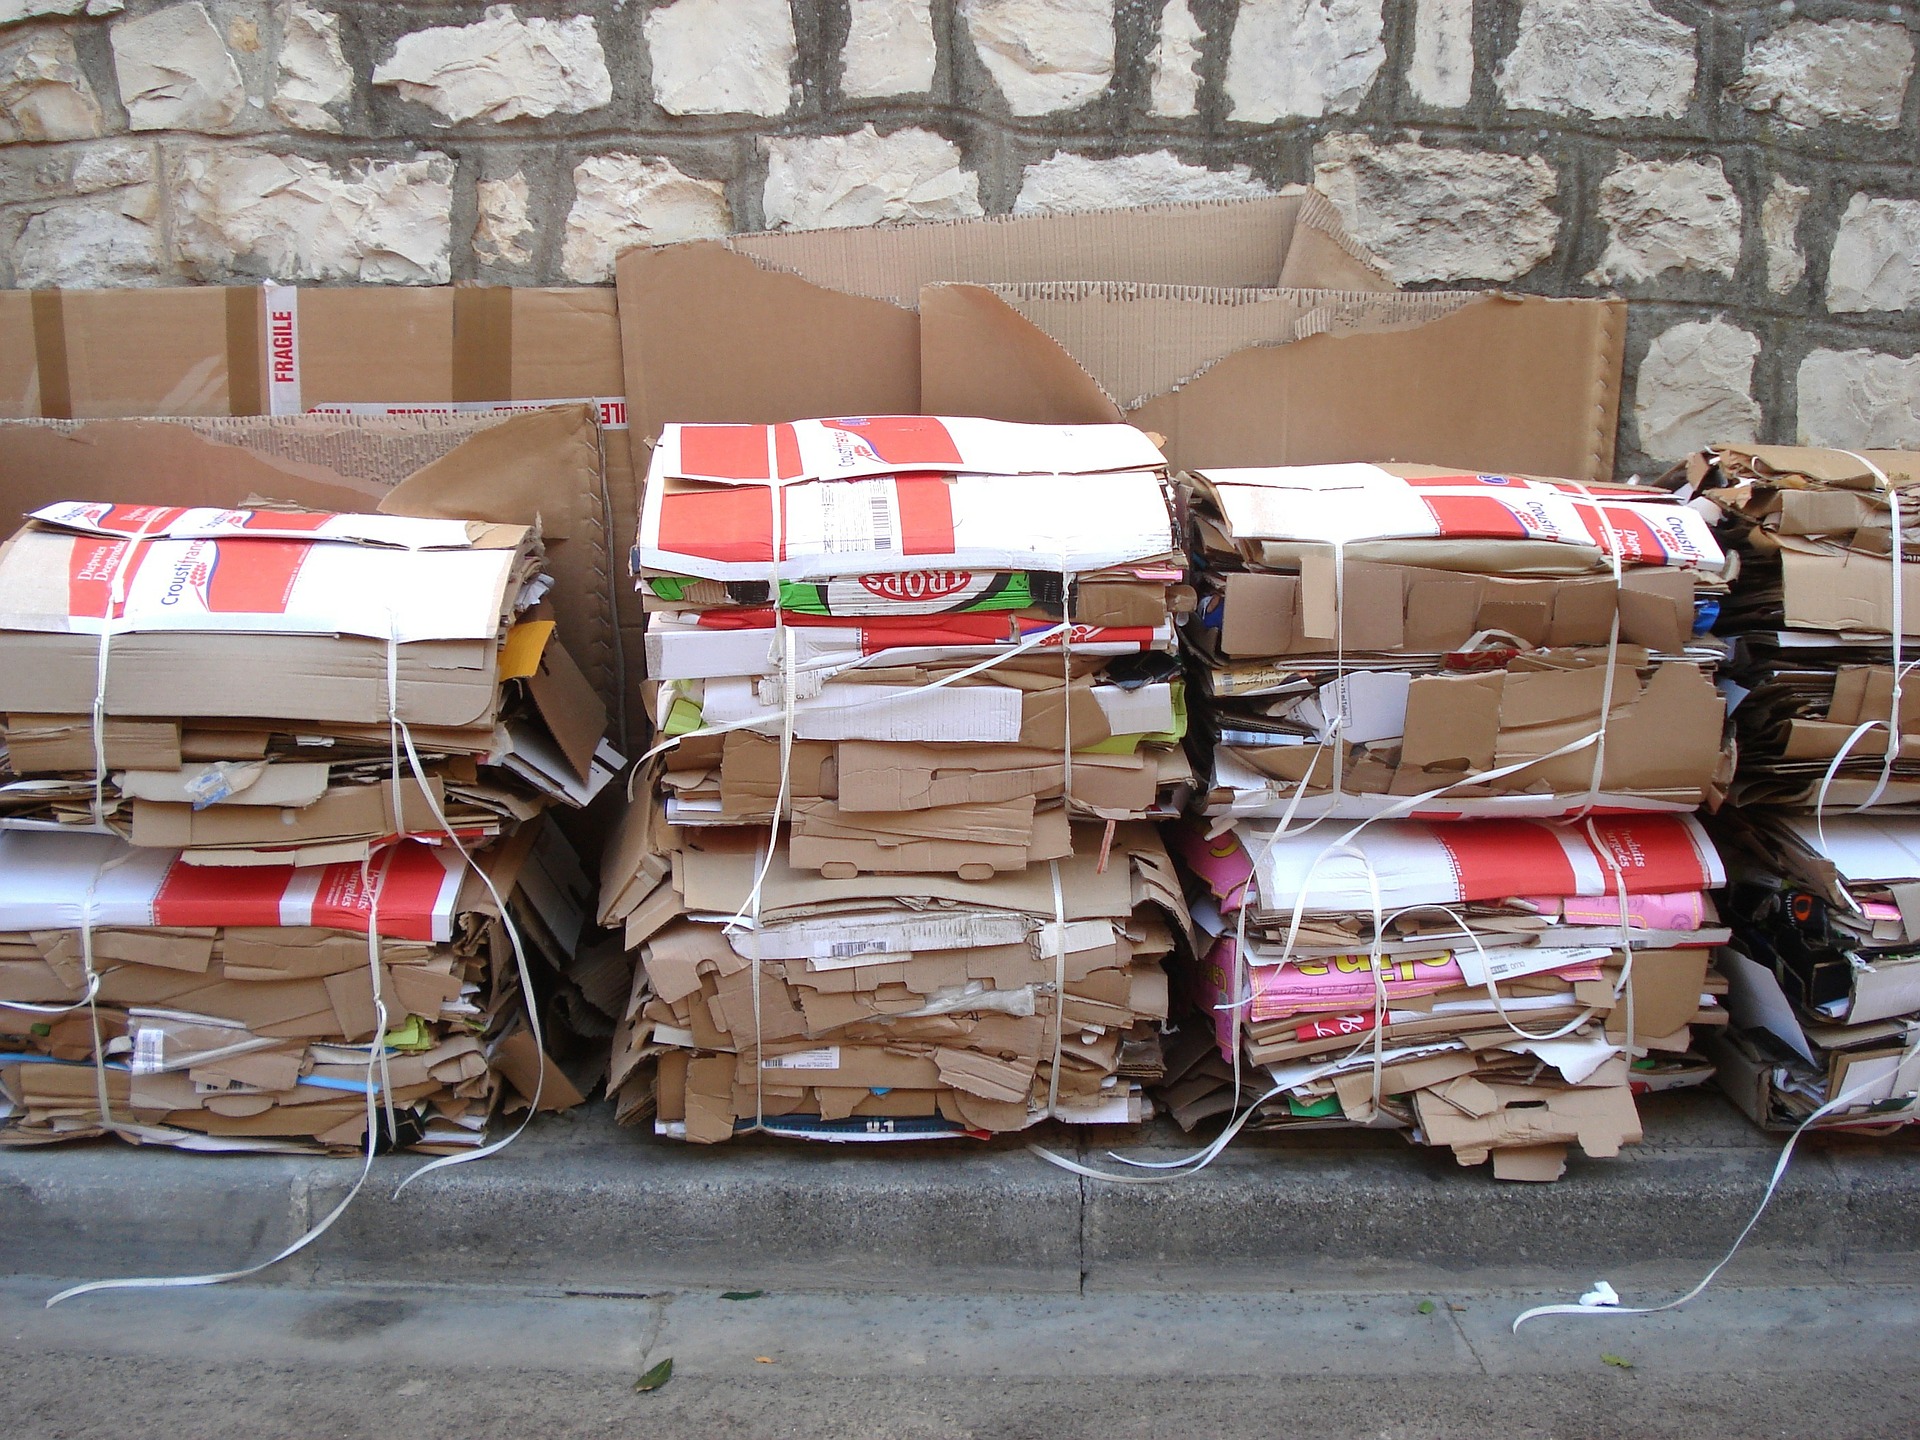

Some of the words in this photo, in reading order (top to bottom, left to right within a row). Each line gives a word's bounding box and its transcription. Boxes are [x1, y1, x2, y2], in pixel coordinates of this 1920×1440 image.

[273, 311, 295, 383] FRAGILE
[866, 571, 971, 598] TROPS
[1606, 829, 1633, 867] urgelés
